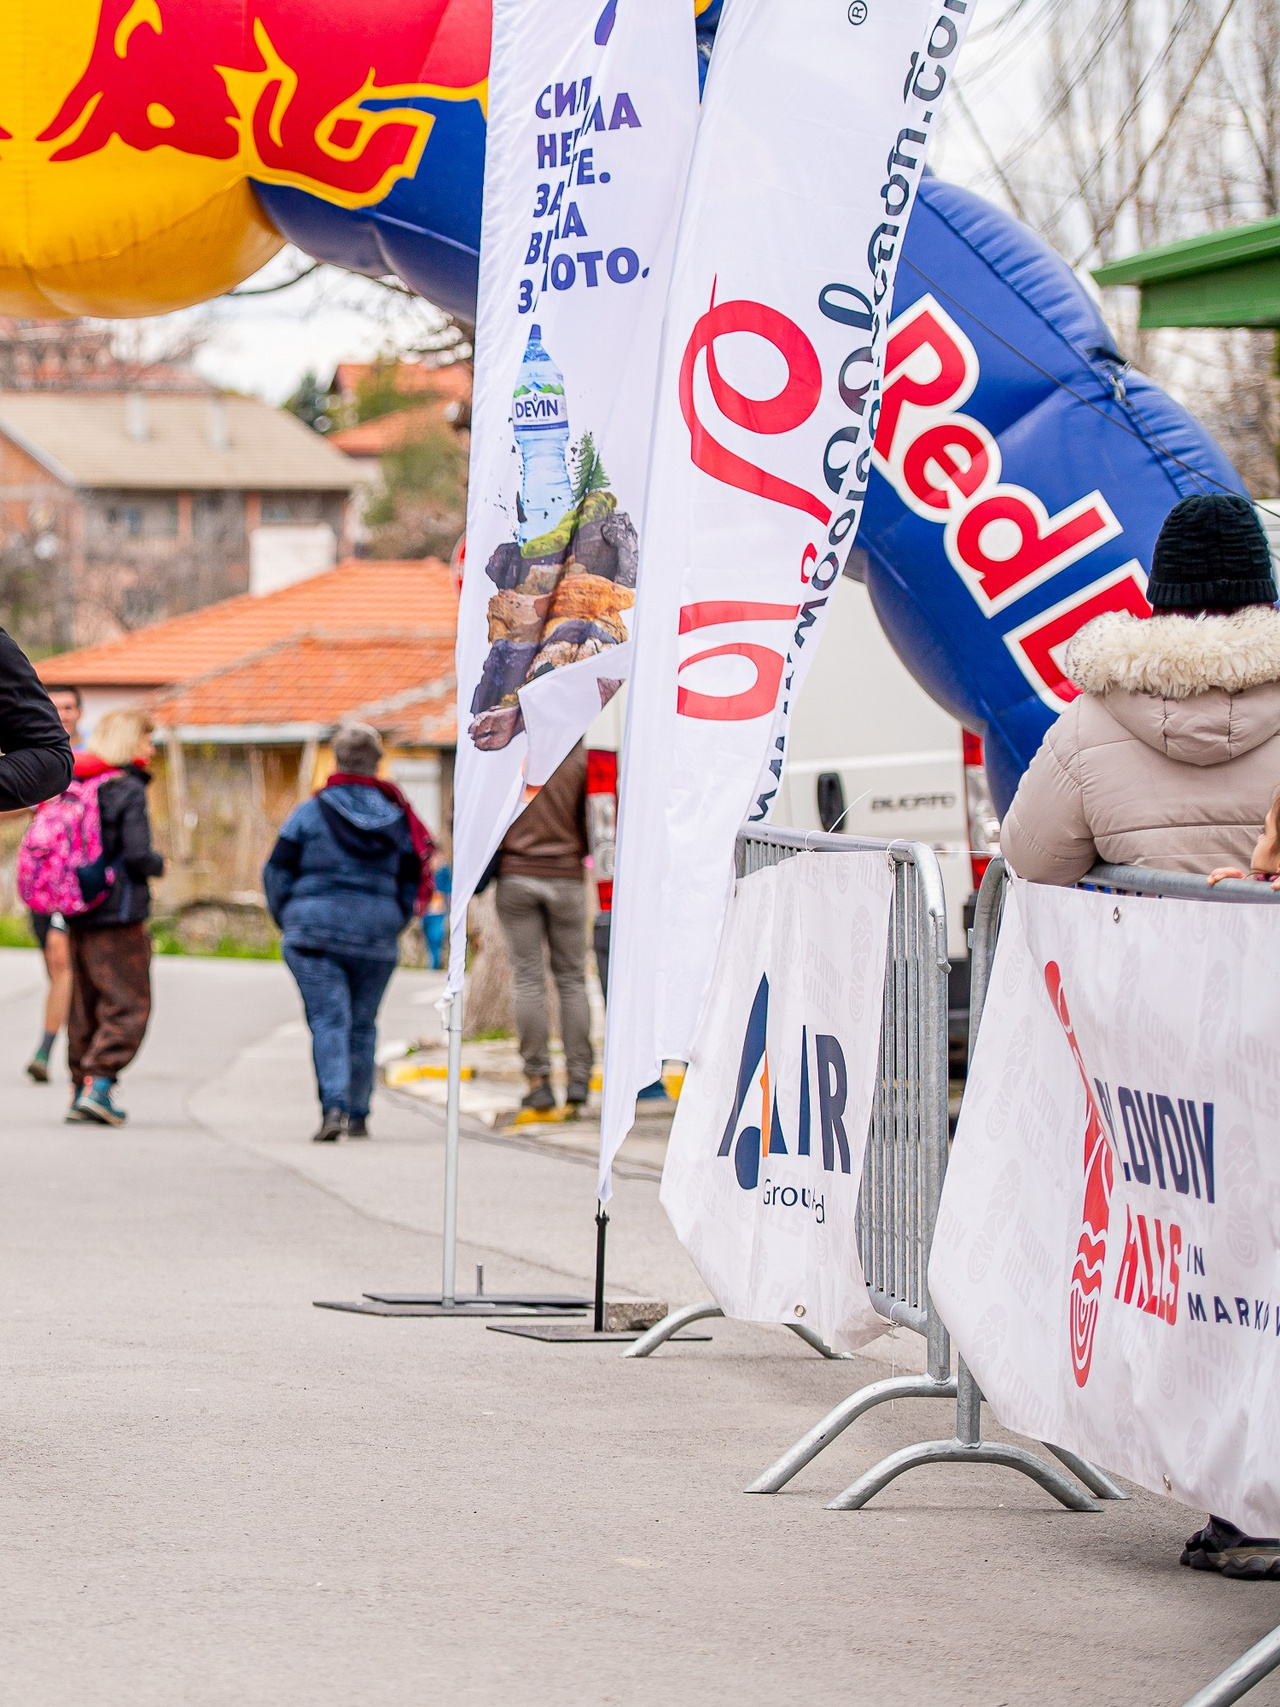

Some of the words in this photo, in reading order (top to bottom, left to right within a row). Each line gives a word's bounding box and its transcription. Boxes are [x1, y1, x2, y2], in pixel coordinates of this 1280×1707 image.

[515, 399, 559, 418] DEVIN
[873, 306, 1110, 604] Red
[1186, 1243, 1206, 1276] IN
